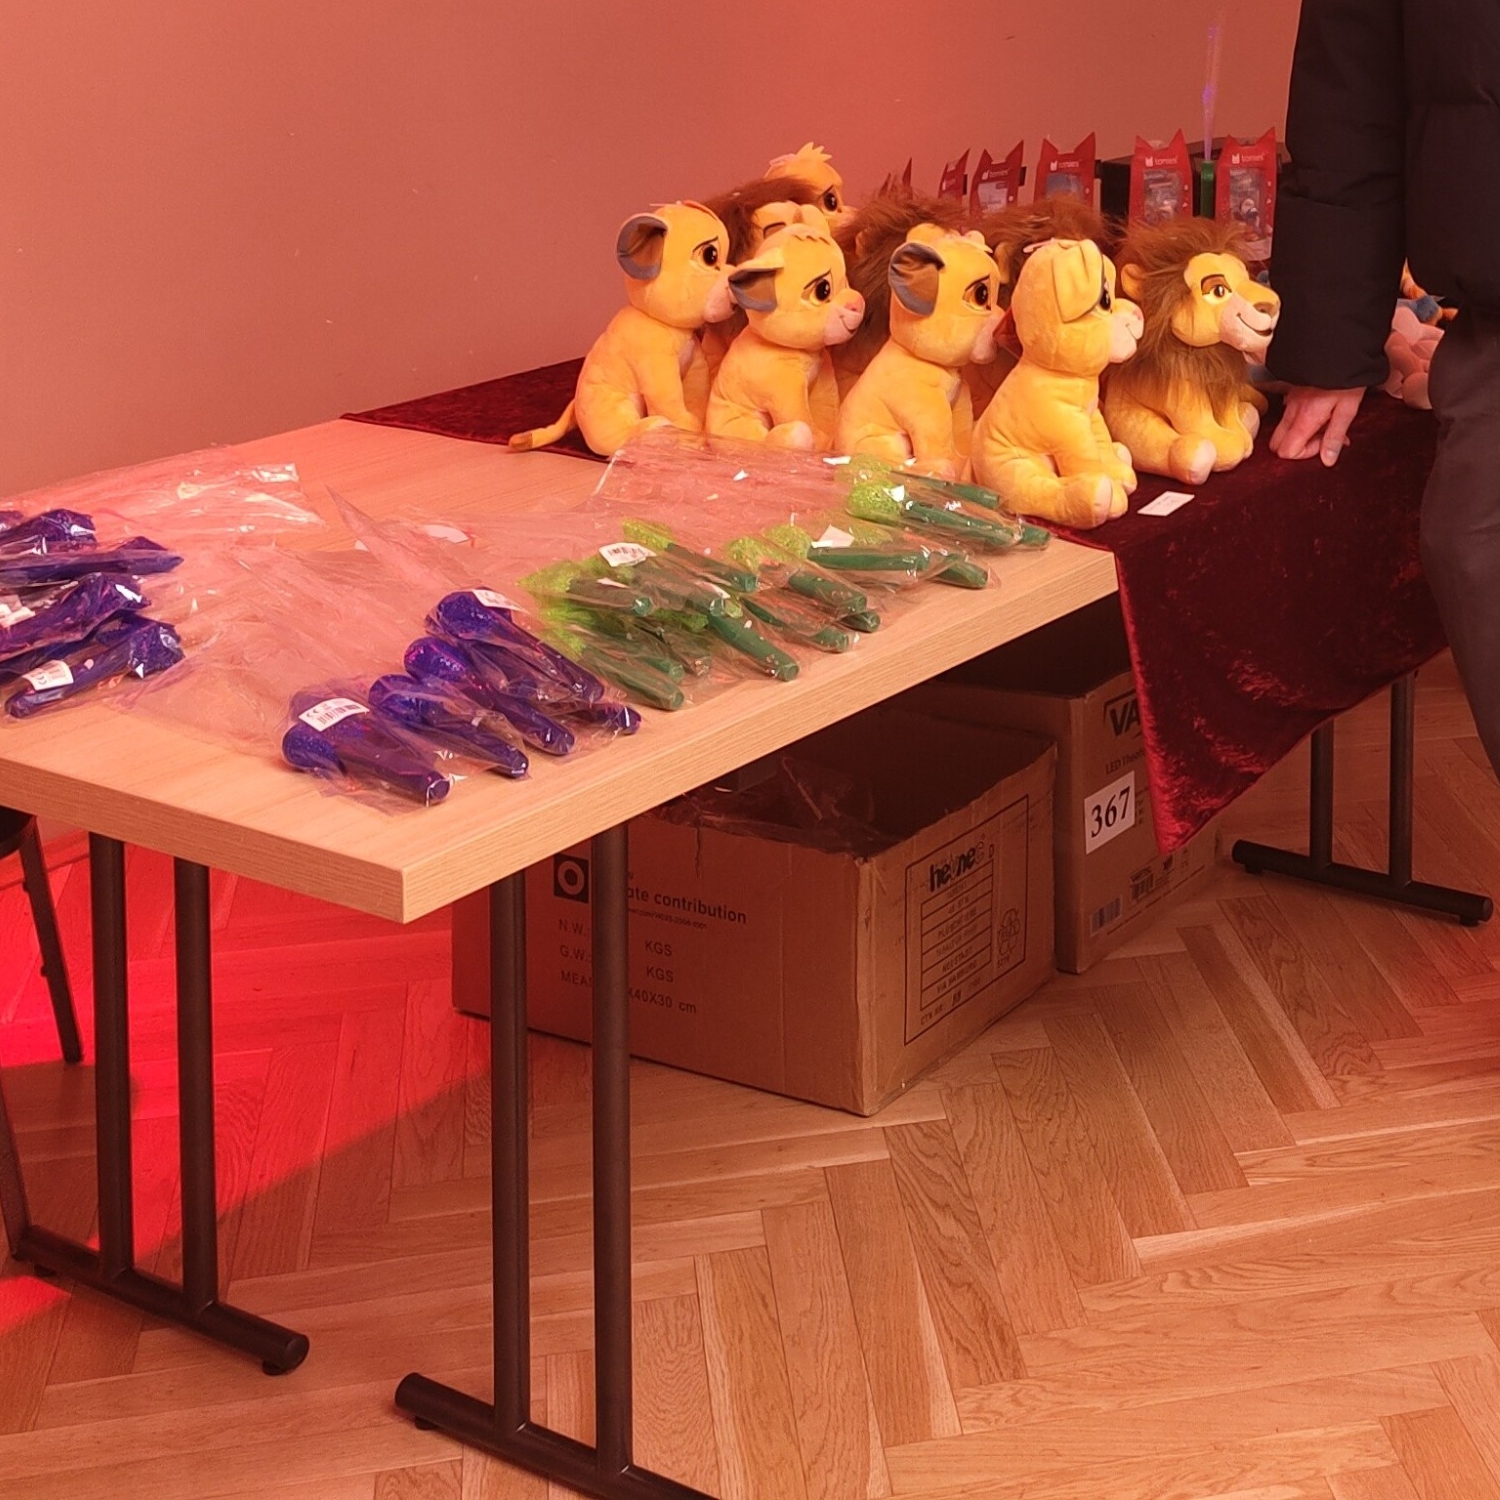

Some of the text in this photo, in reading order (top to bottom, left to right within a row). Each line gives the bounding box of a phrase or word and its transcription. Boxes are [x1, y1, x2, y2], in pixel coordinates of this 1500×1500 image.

[1090, 785, 1131, 838] 367
[654, 890, 747, 925] contribution
[645, 940, 673, 957] KGS
[646, 966, 674, 983] KGS
[678, 1001, 697, 1014] cm
